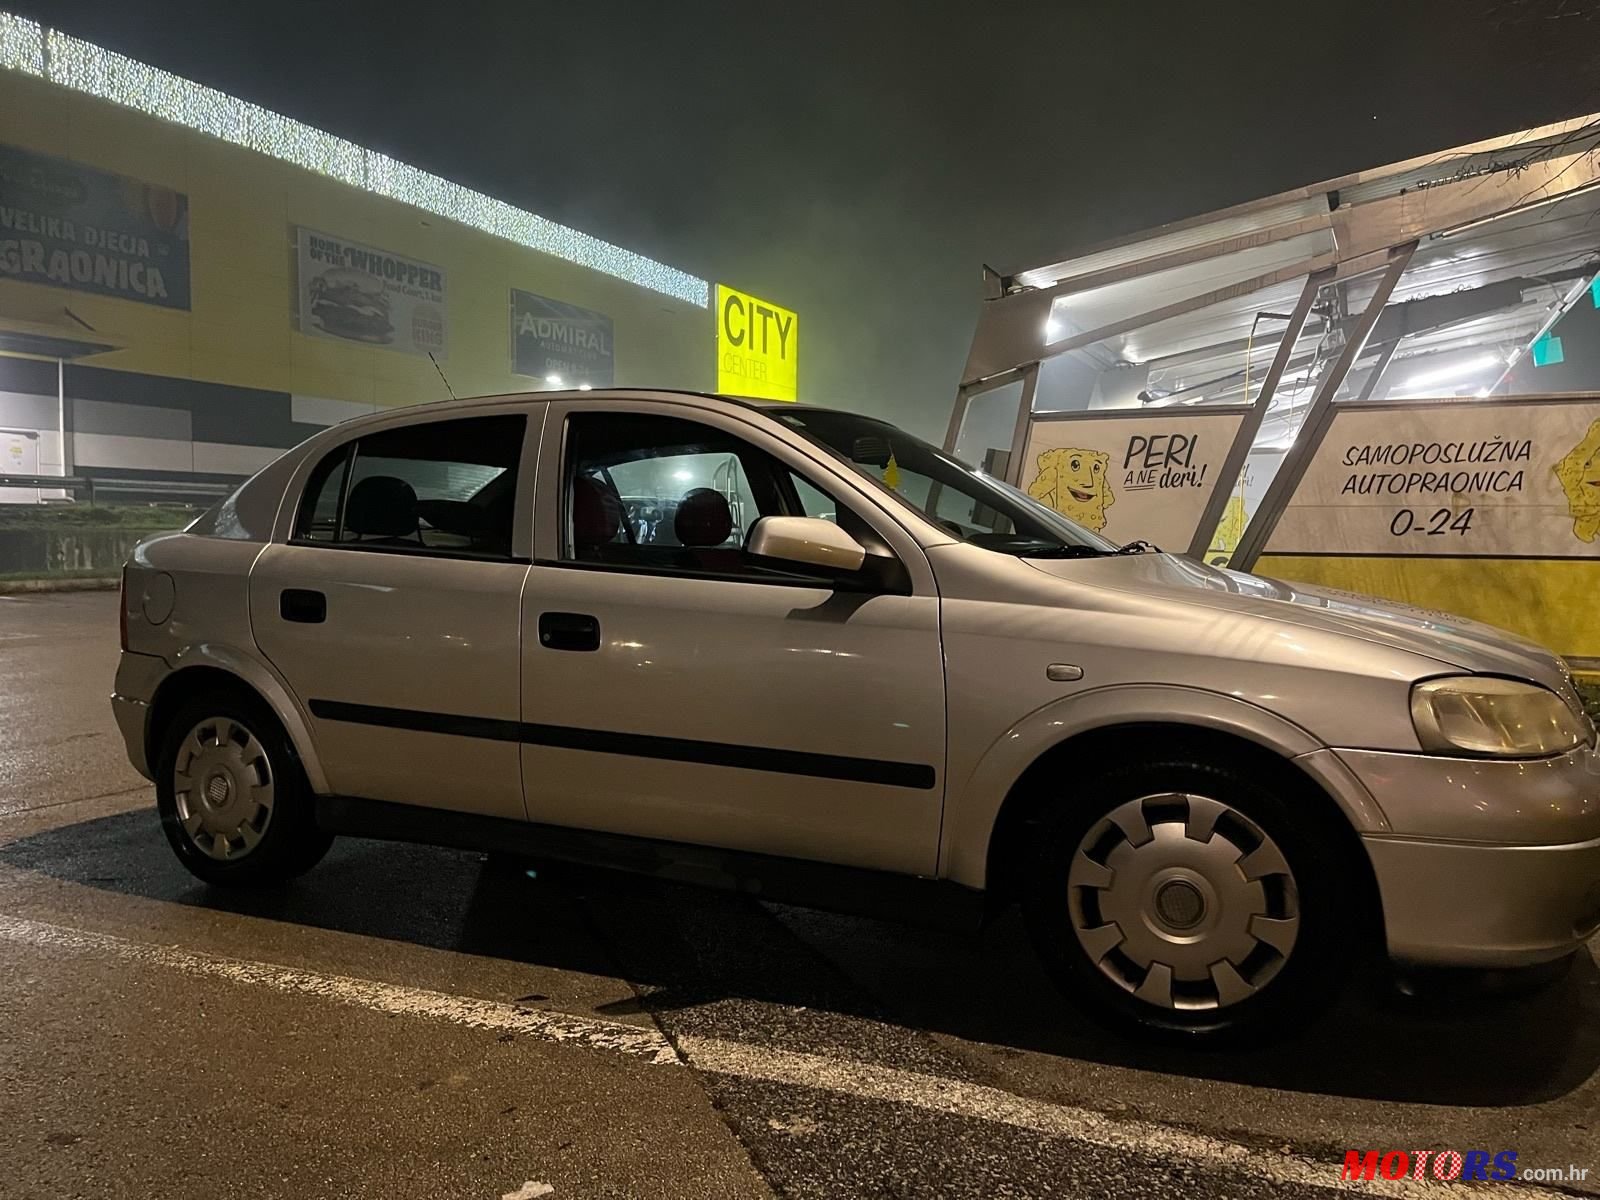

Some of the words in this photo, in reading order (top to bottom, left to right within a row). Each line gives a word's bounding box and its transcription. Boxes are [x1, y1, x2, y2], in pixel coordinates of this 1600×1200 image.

[1, 207, 76, 241] VELIKA
[310, 235, 343, 253] HOME
[324, 252, 345, 267] THE
[343, 247, 442, 292] WHOPPER
[520, 311, 610, 356] ADMIRAL
[724, 294, 792, 360] CITY
[723, 352, 767, 382] CENTER
[1342, 435, 1532, 466] SAMOPOSLUŽNA
[1159, 463, 1207, 488] deri!
[1341, 470, 1524, 495] AUTOPRAONICA
[1390, 508, 1475, 536] 0-24
